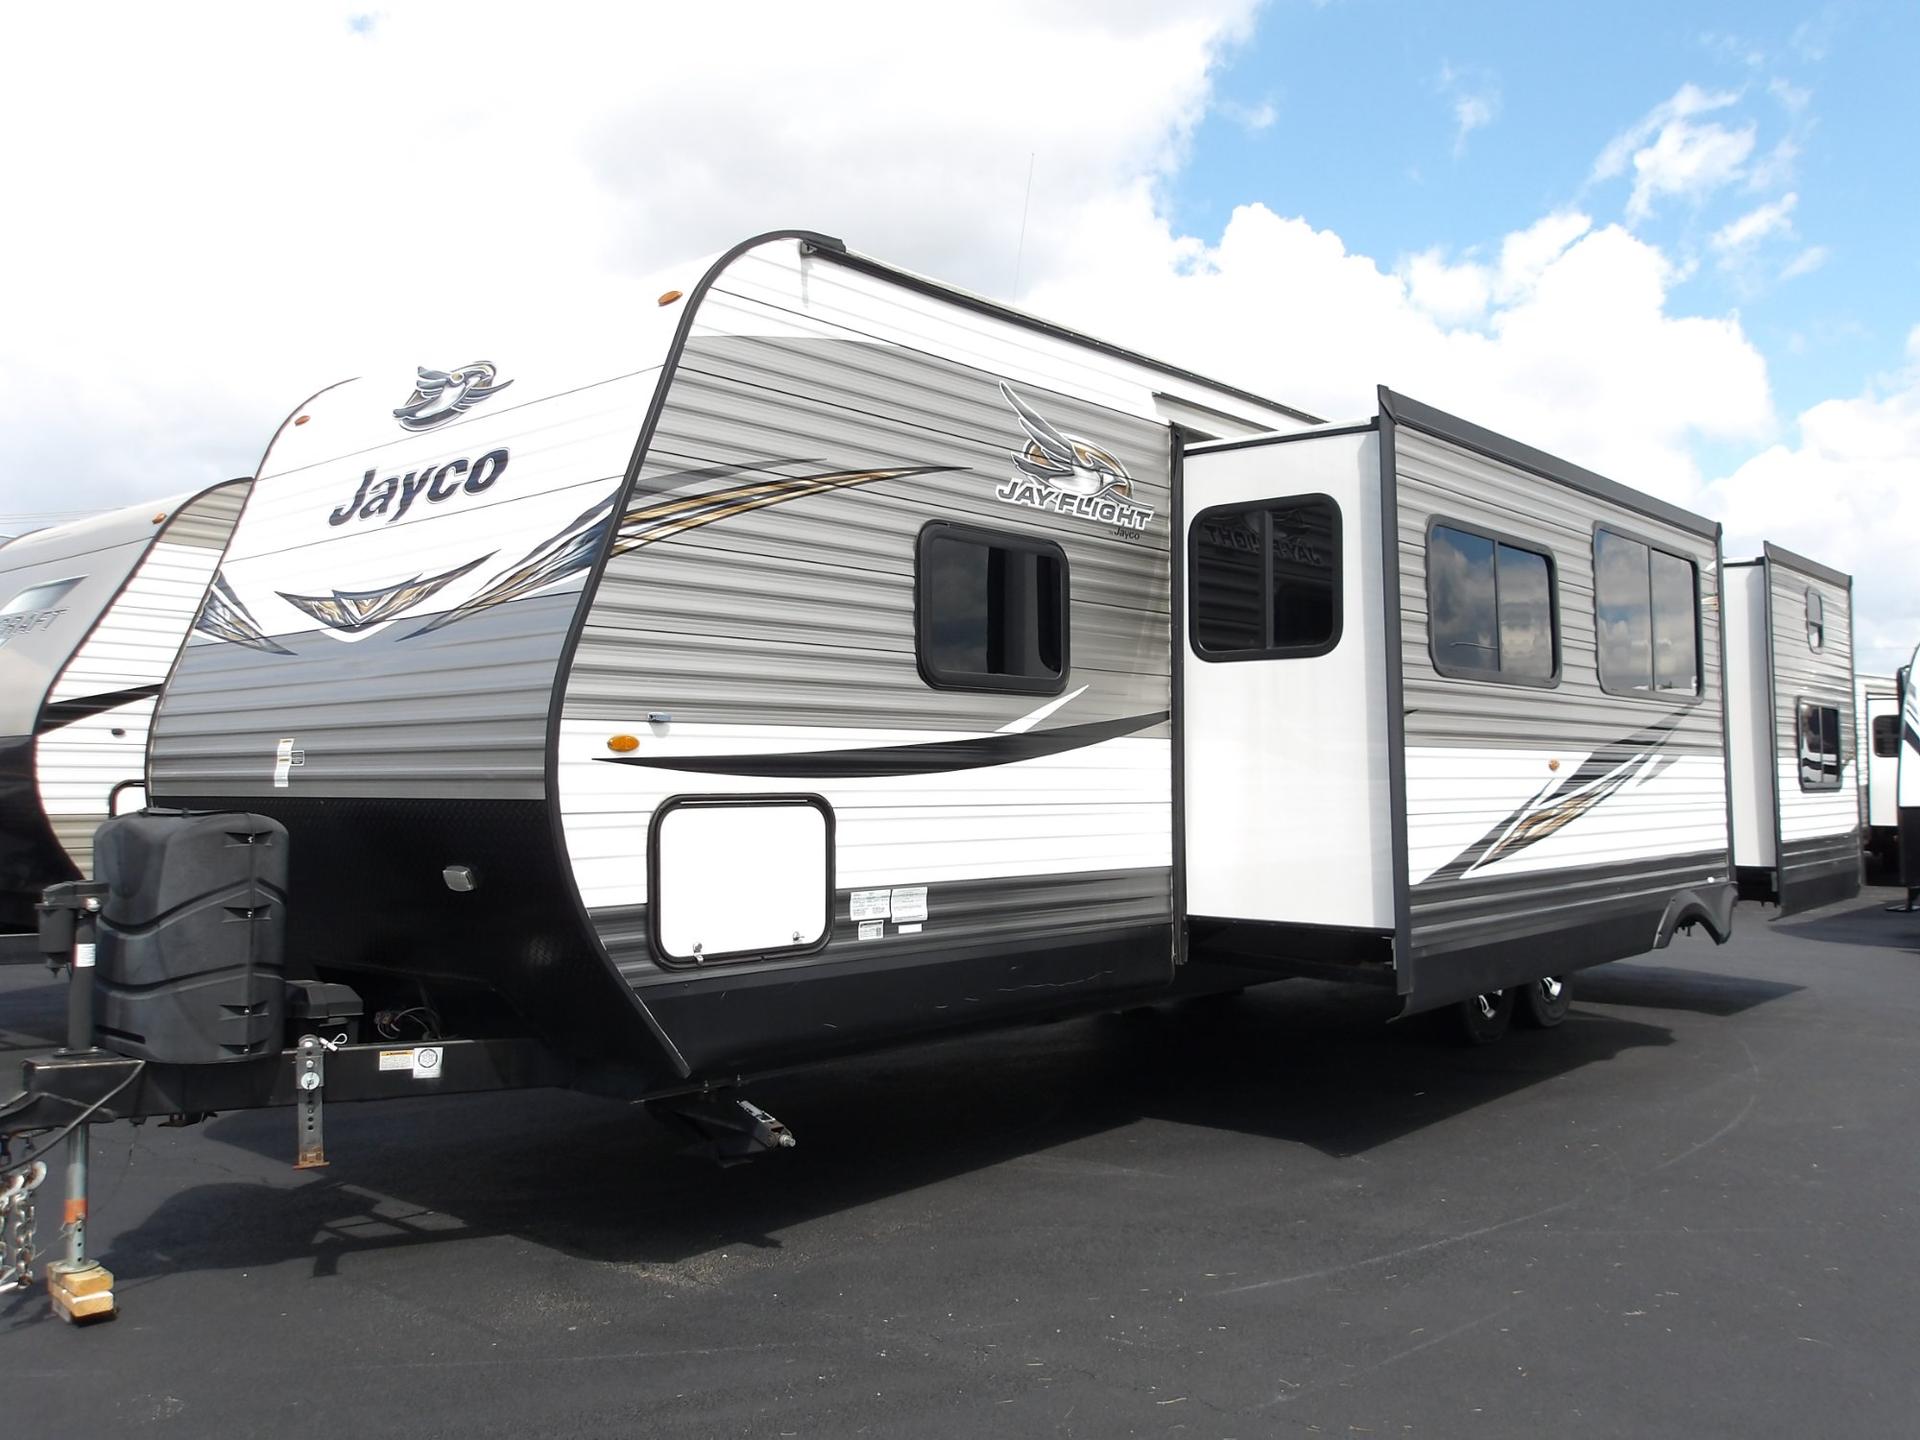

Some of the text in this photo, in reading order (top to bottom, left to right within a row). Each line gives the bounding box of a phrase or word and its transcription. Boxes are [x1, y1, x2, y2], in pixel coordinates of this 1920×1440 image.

[329, 447, 509, 526] Jayco
[996, 479, 1153, 530] JAY FLIGHT
[1113, 527, 1141, 540] Jayco
